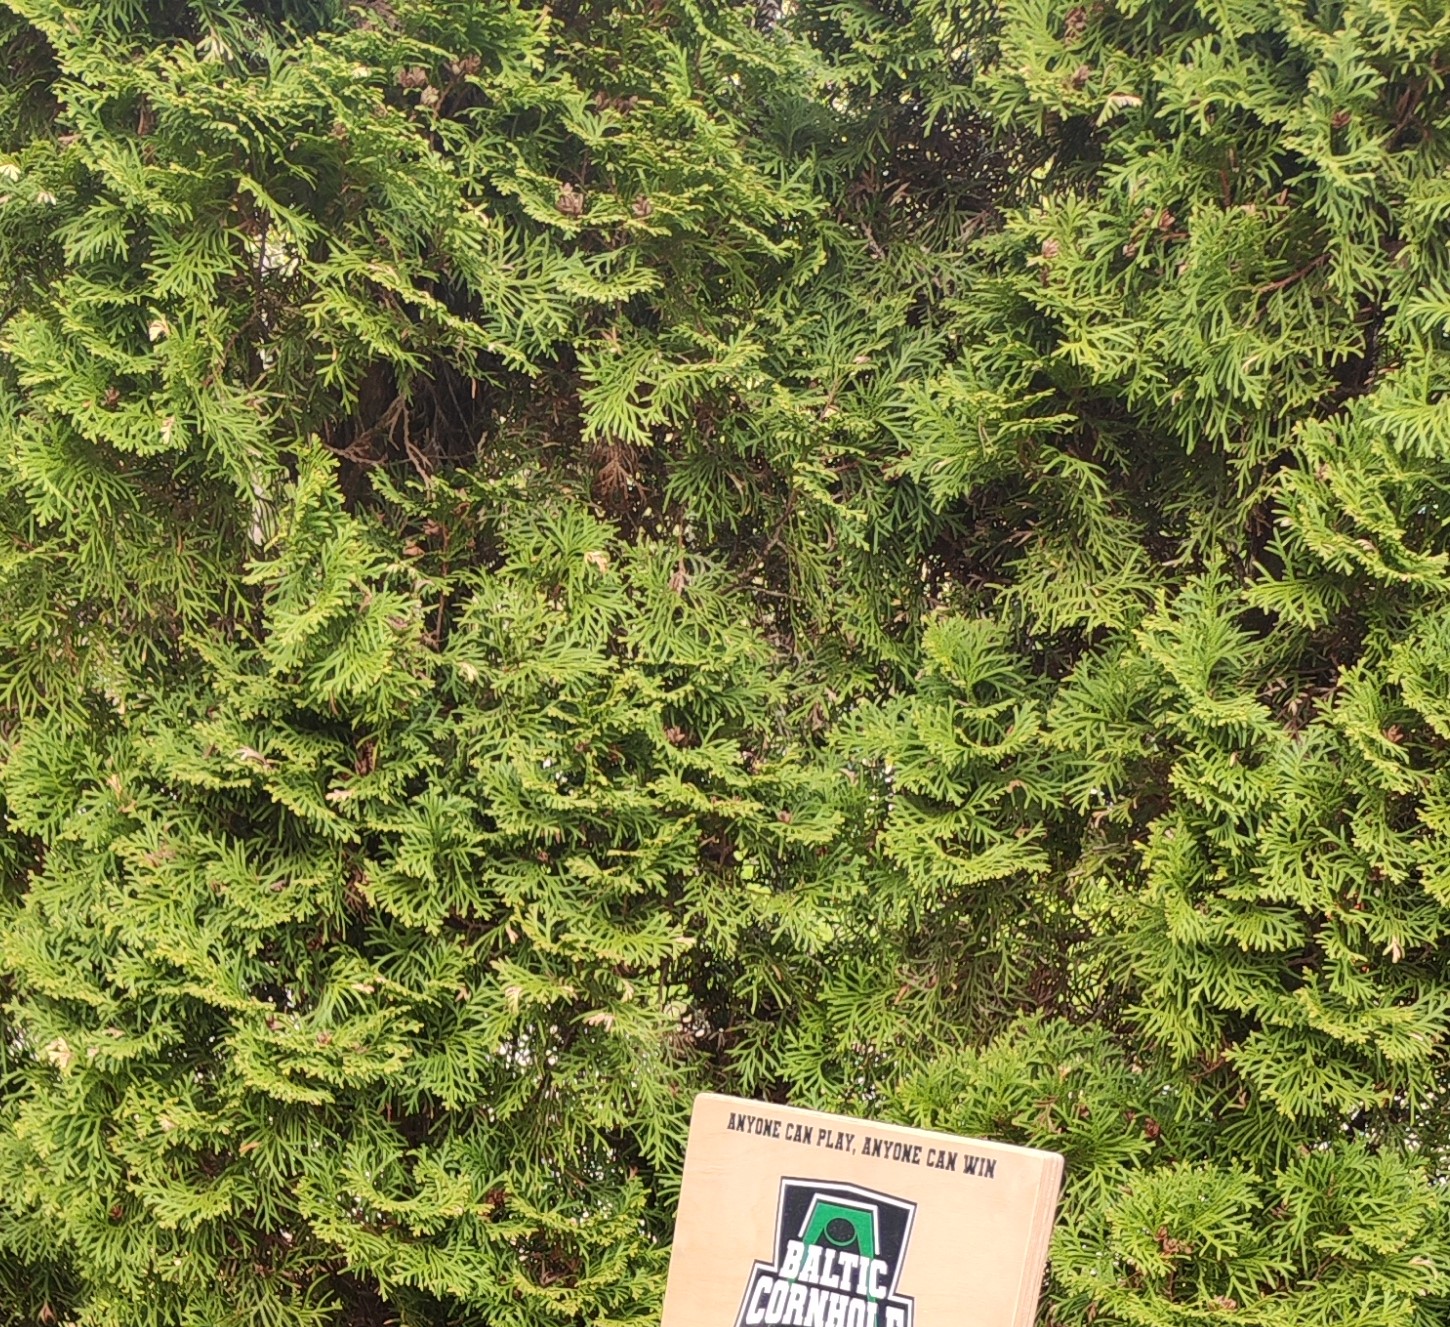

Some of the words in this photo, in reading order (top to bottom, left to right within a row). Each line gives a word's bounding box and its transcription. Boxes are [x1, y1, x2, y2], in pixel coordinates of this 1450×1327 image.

[727, 1112, 781, 1139] ANYONE
[785, 1119, 814, 1146] CAN
[818, 1129, 855, 1154] PLAY,
[862, 1138, 923, 1166] ANYONE
[926, 1148, 960, 1173] CAN
[963, 1155, 997, 1179] WIN
[779, 1239, 888, 1296] BALTIC
